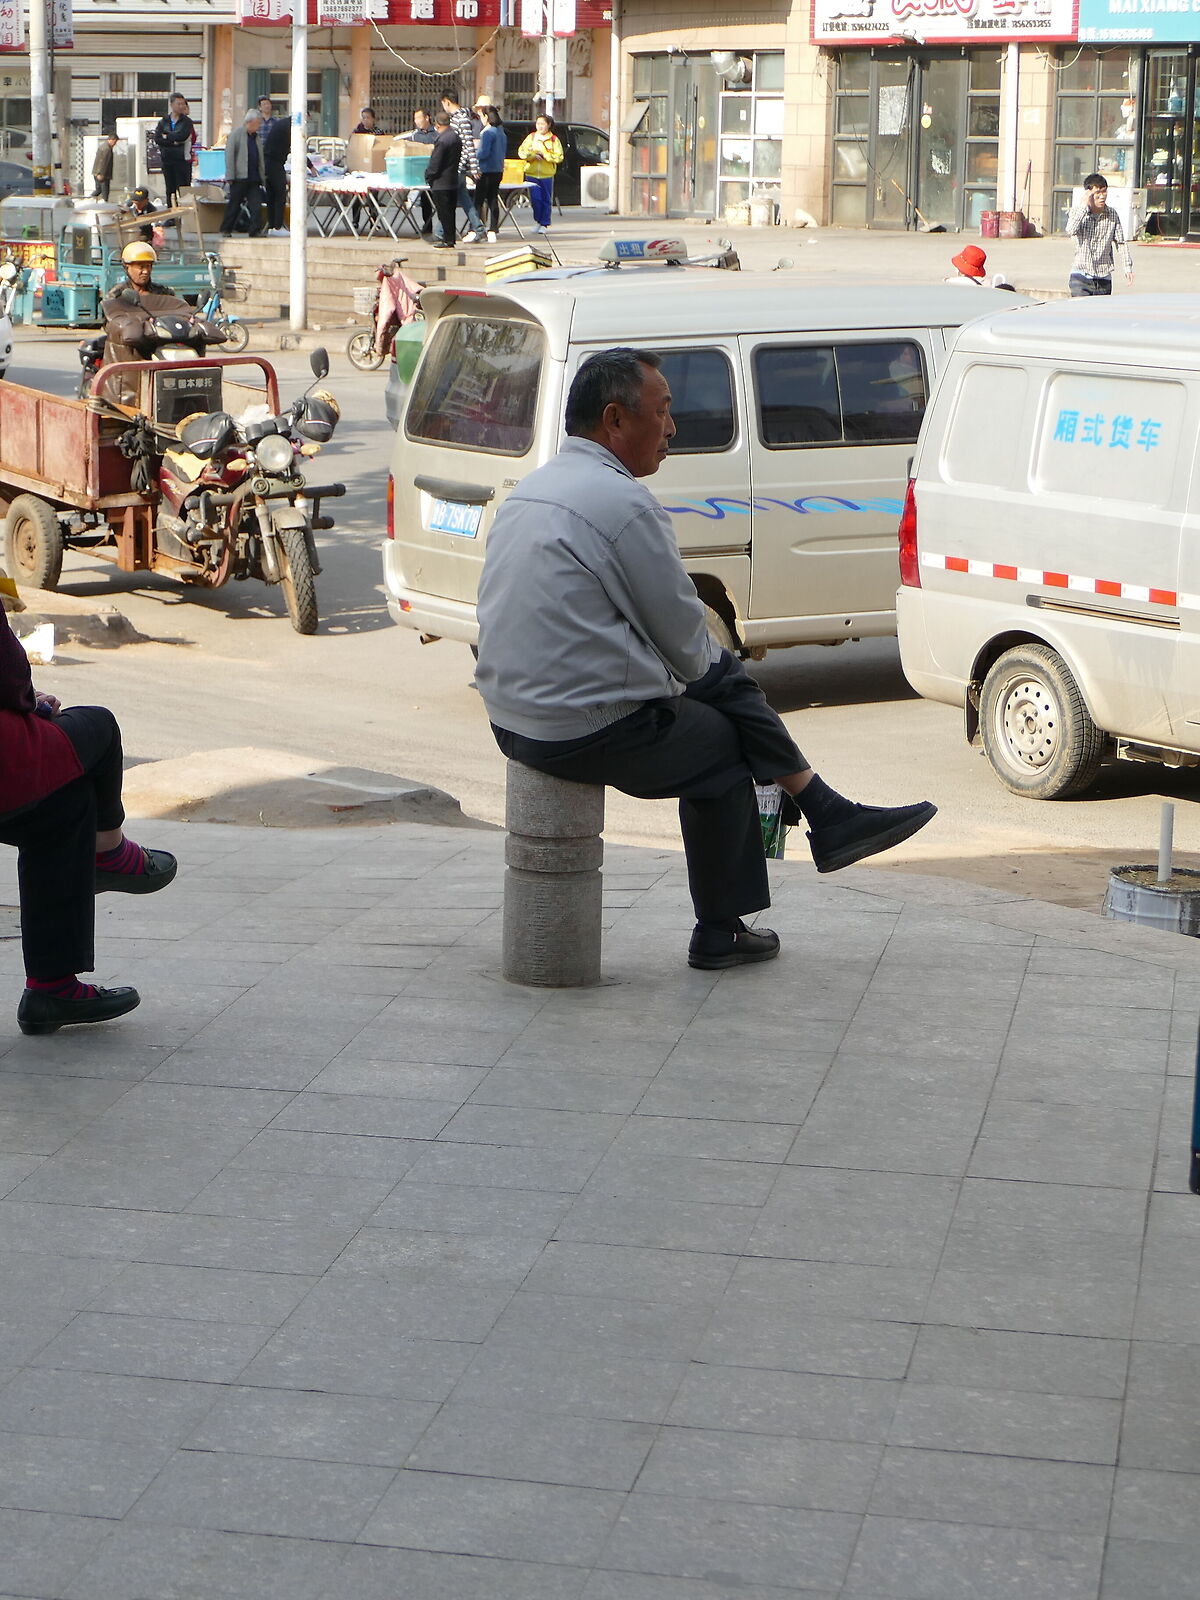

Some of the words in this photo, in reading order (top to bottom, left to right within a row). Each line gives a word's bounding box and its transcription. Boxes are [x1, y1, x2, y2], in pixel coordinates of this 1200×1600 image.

[0, 0, 13, 44] 幼儿园
[619, 242, 643, 256] 出租
[1053, 409, 1164, 453] 厢式货车
